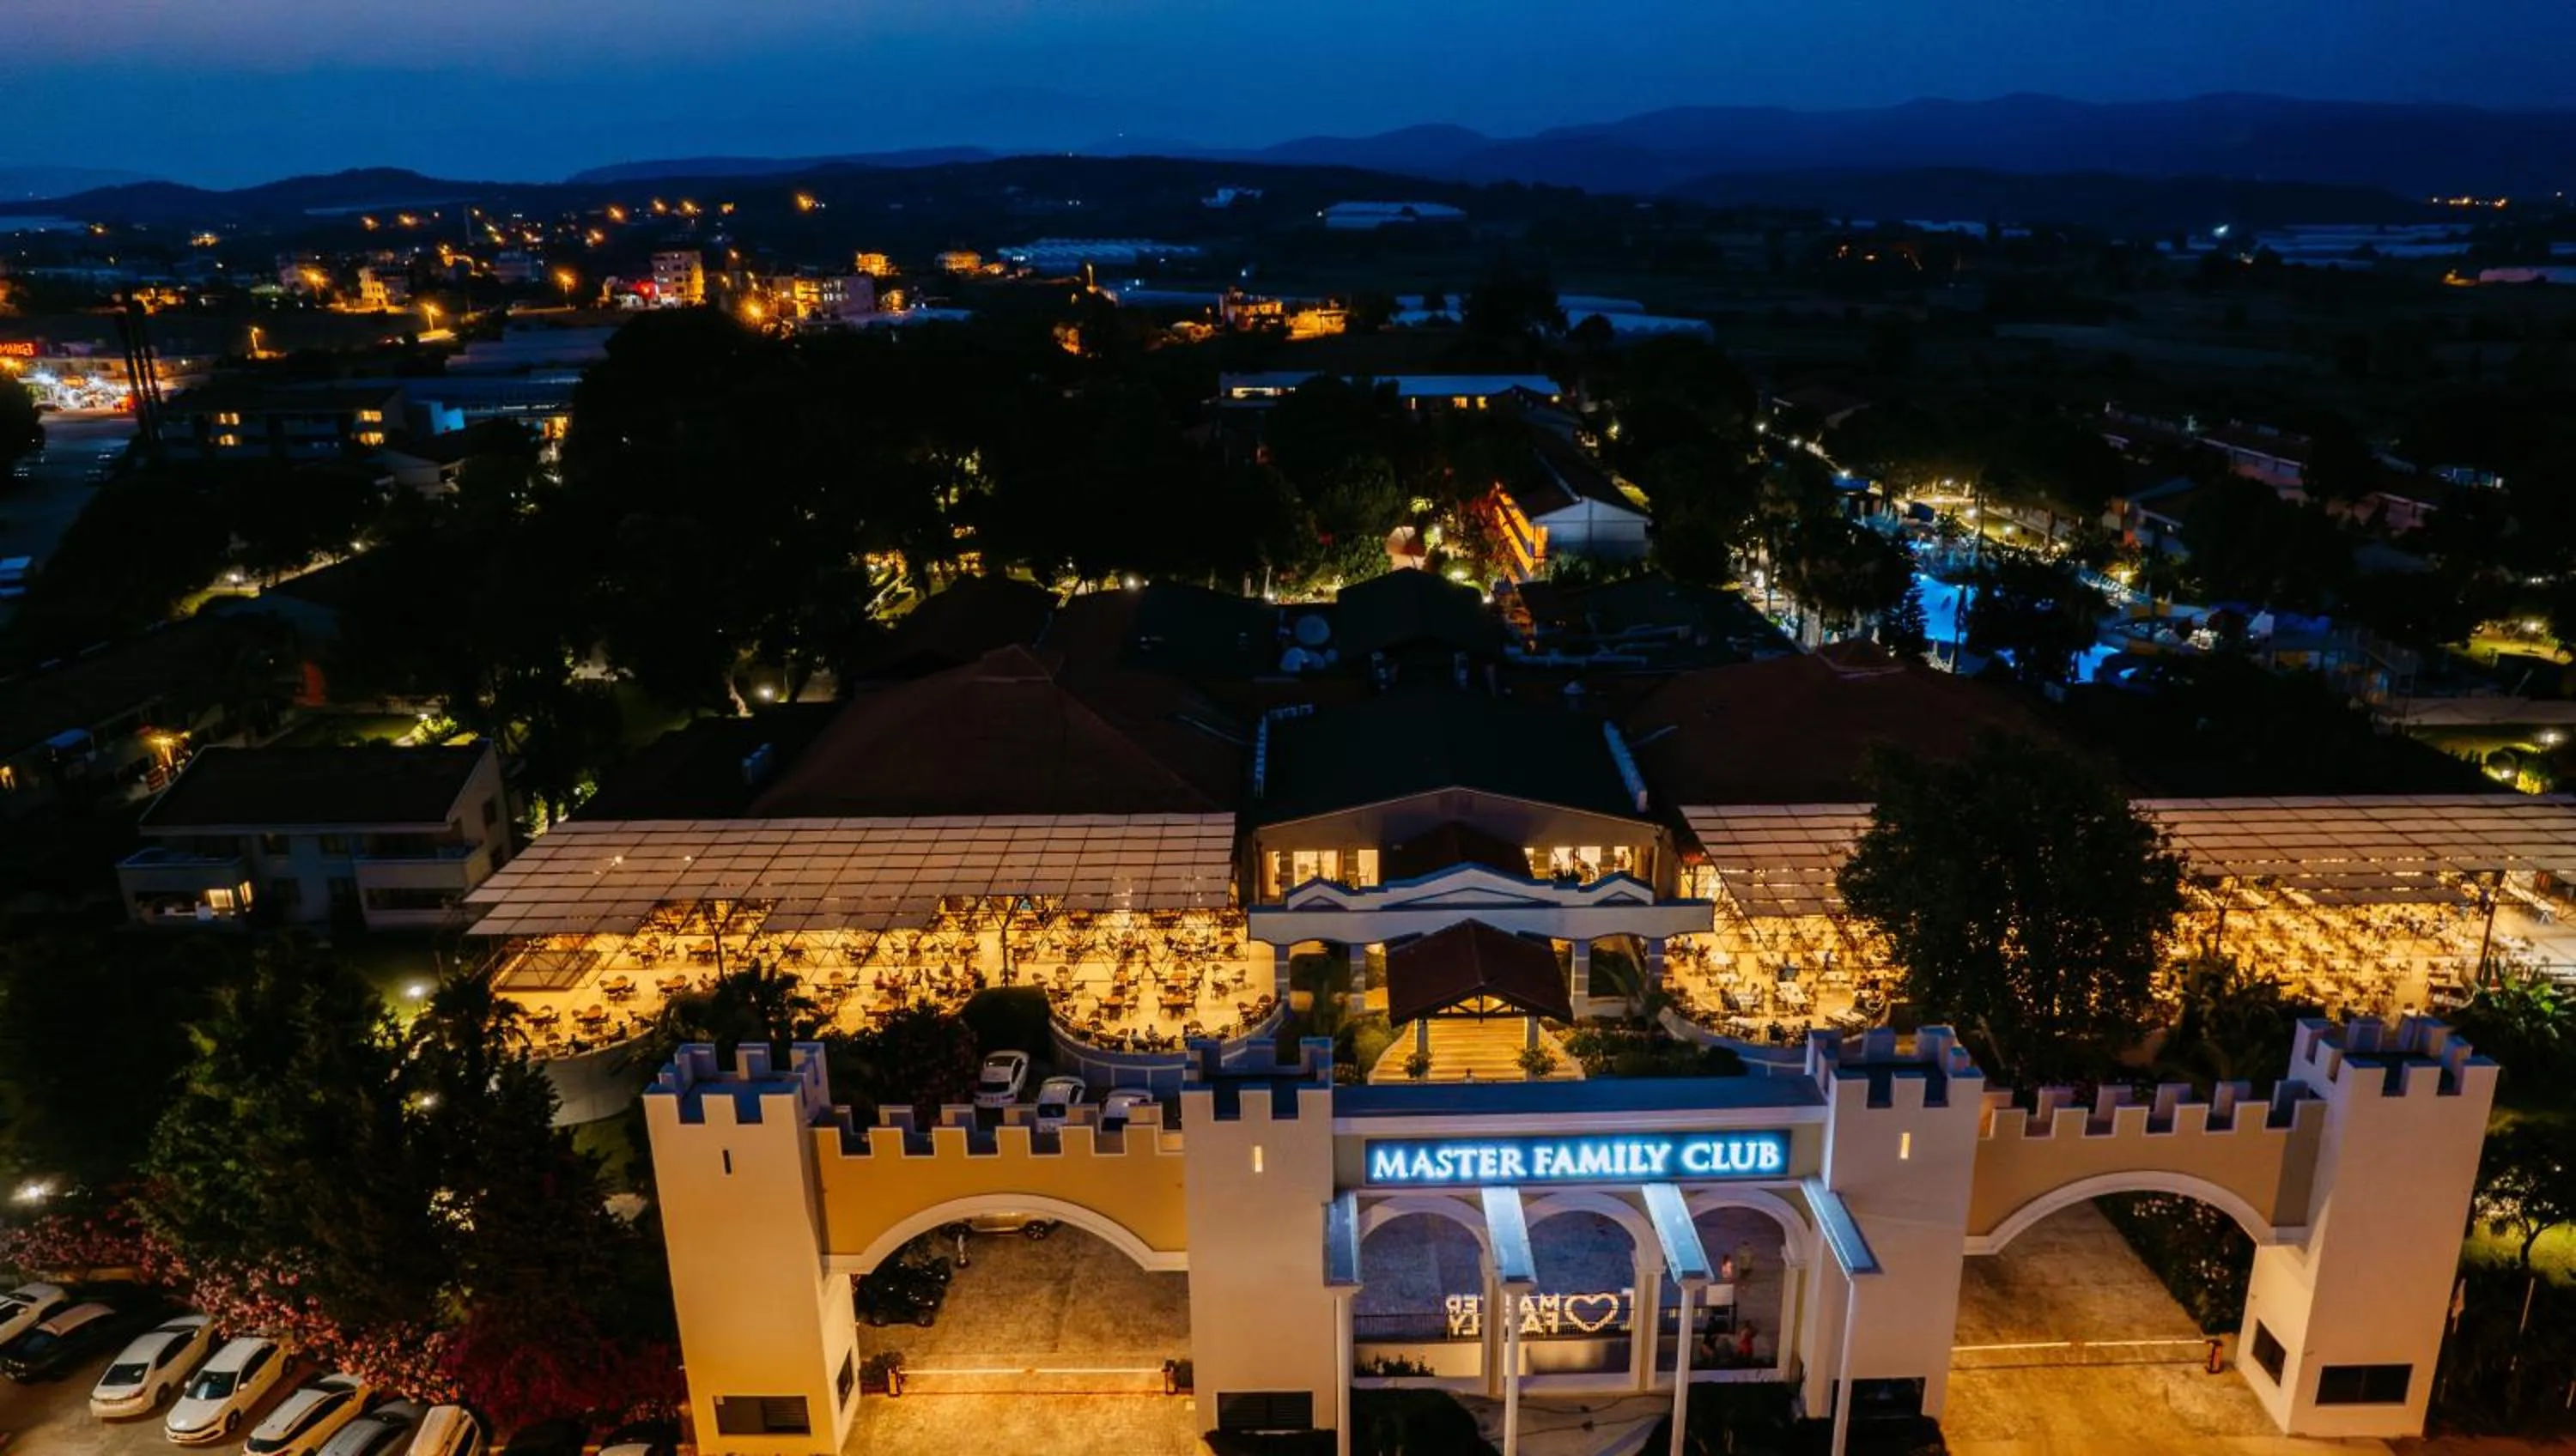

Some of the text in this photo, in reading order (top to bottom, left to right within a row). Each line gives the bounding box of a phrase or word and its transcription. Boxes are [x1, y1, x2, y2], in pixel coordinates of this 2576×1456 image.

[1372, 1141, 1781, 1179] MASTER FAMILY CLUB
